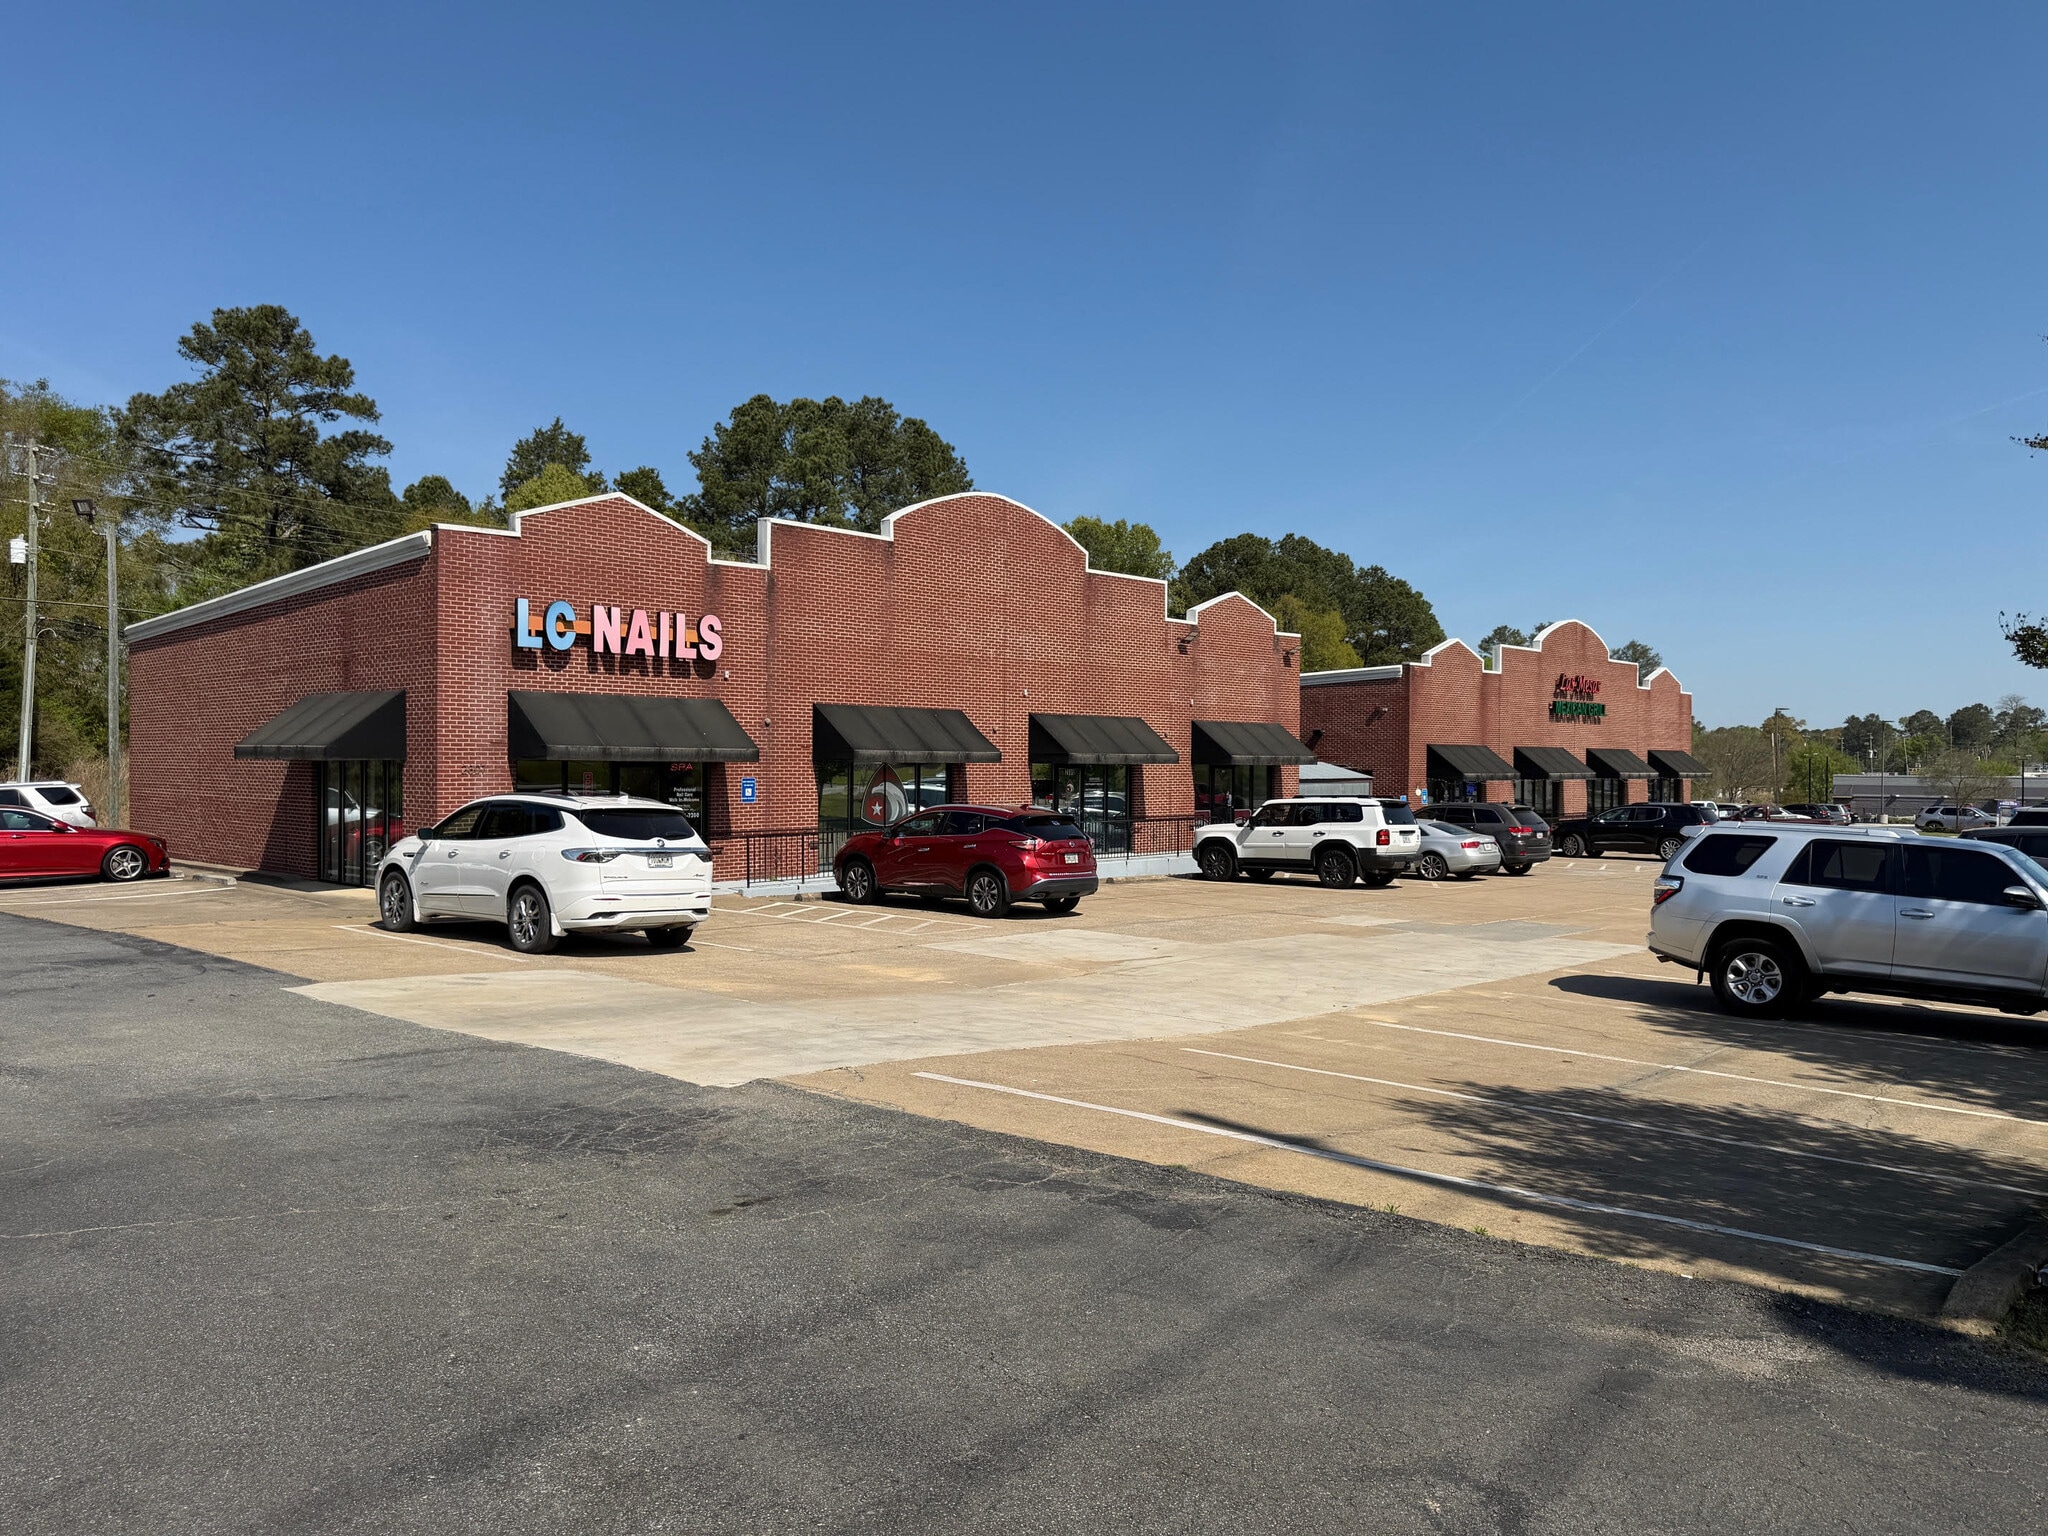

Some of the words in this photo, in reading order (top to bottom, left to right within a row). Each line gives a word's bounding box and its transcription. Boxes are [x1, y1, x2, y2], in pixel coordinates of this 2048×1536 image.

[515, 597, 577, 651] LC
[592, 603, 723, 661] NAILS
[1555, 700, 1587, 716] MEXICAN
[670, 762, 694, 771] SPA
